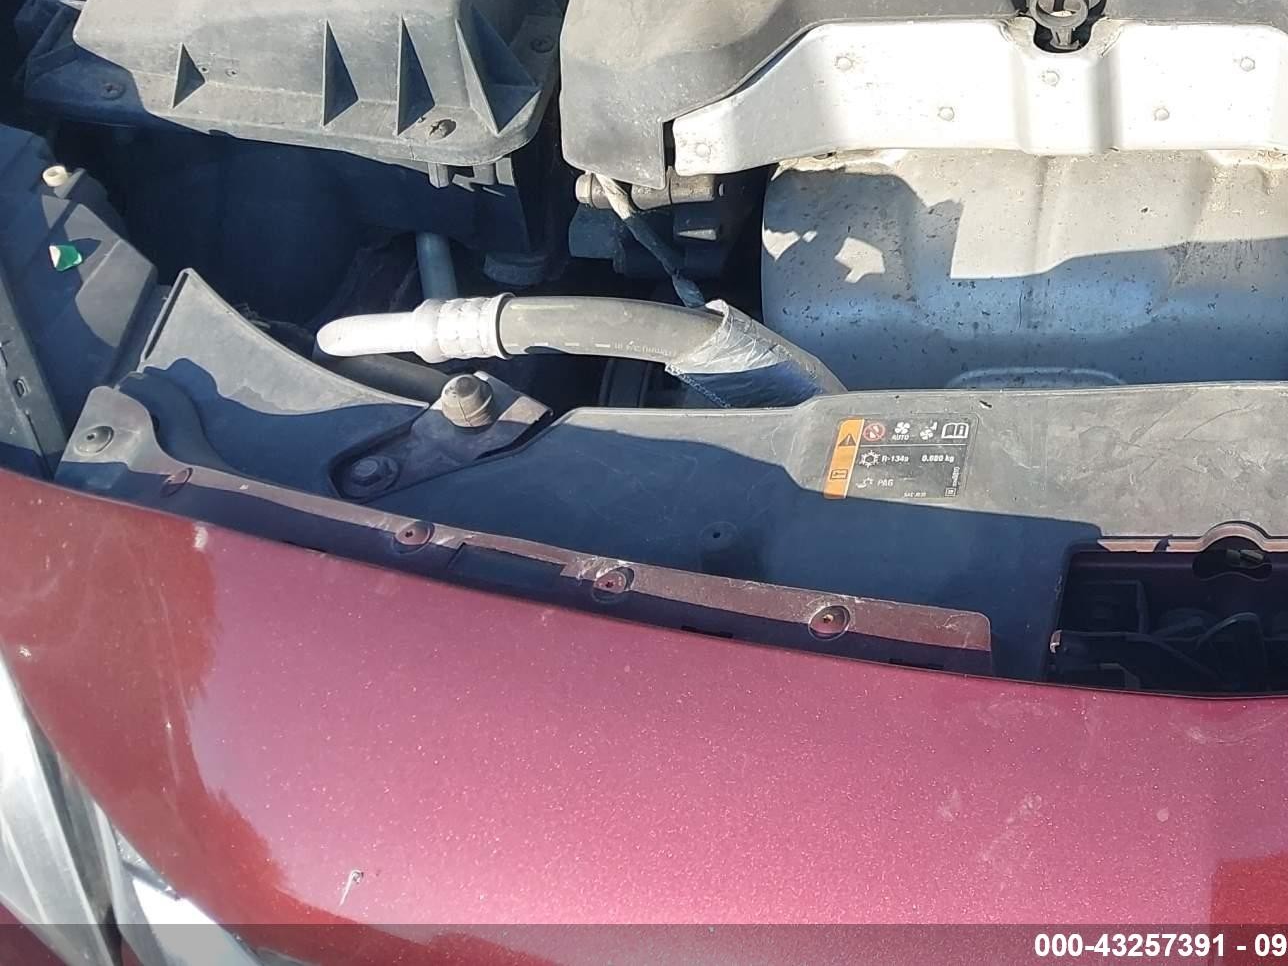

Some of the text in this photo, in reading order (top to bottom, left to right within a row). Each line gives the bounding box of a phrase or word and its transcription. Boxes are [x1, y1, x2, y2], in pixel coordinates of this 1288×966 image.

[891, 433, 909, 441] AUTO
[881, 454, 909, 463] R-134a
[944, 454, 955, 464] kg
